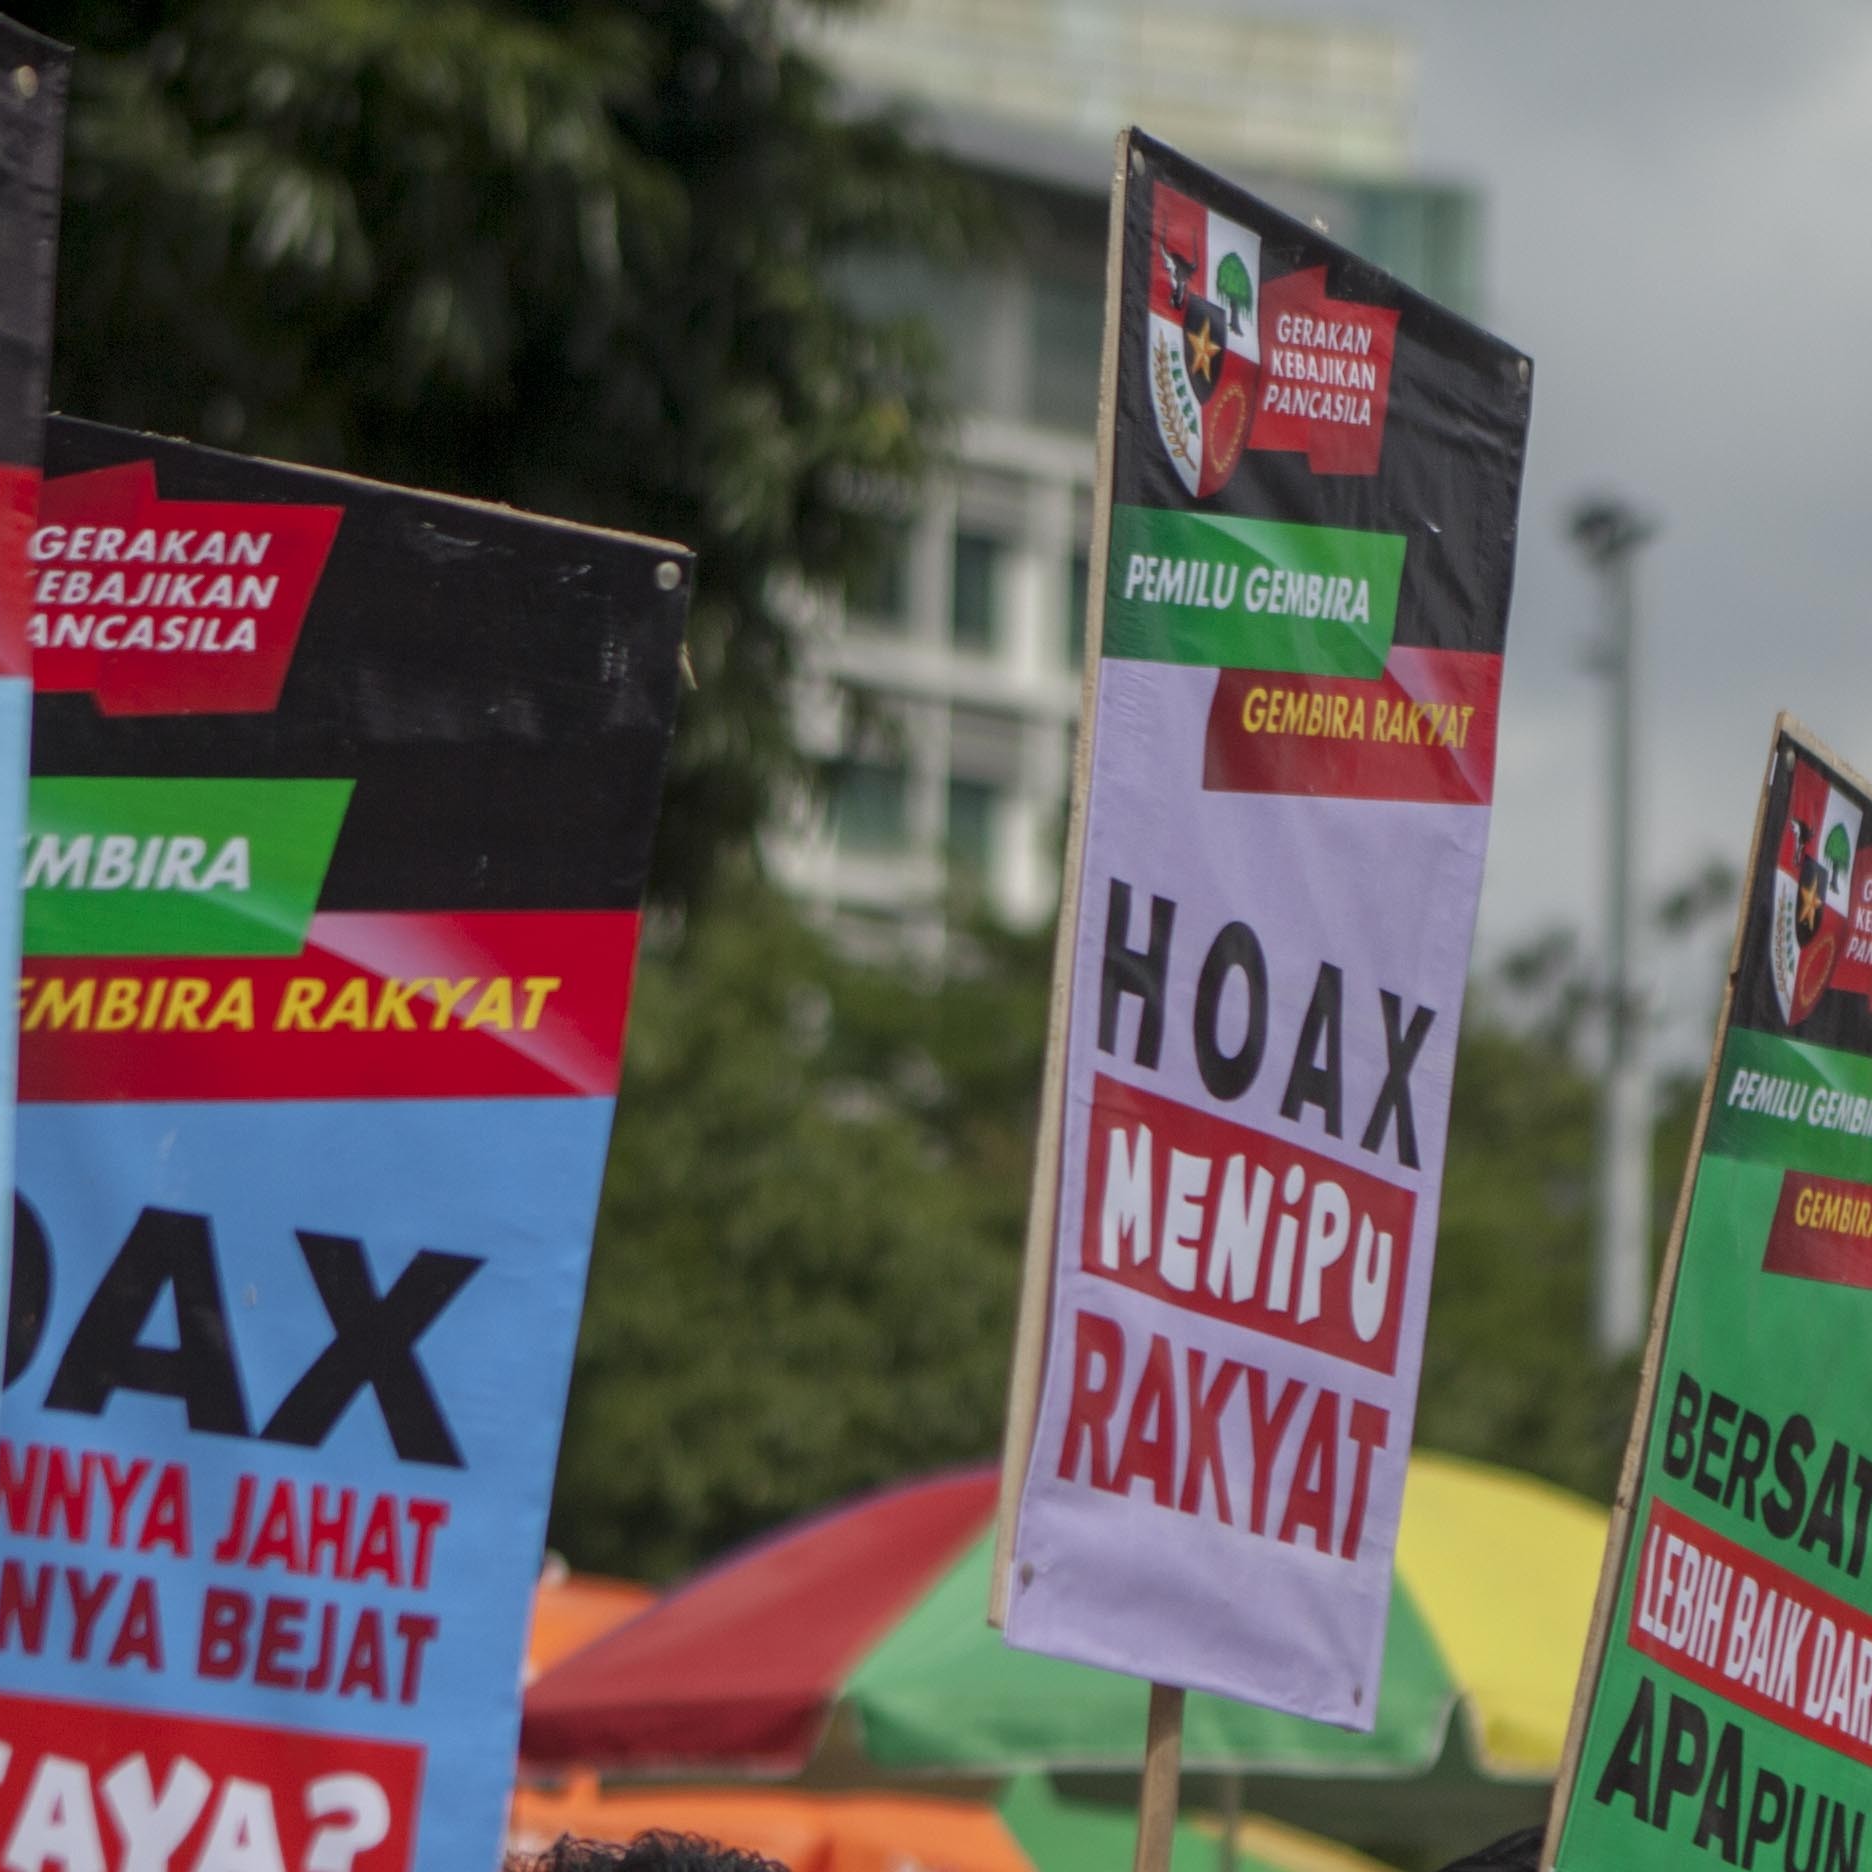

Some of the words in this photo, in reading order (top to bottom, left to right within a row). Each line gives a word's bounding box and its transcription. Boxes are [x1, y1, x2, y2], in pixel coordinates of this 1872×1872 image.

[1277, 314, 1372, 353] GERAKAN
[1271, 350, 1376, 391] KEBAJIKAN
[1263, 386, 1371, 426] PANCASILA
[29, 525, 272, 566] GERAKAN
[28, 569, 280, 610] EBAJIKAN
[1126, 554, 1237, 608] PEMILU
[1245, 566, 1370, 623] GEMBIRA
[27, 613, 258, 653] ANCASILA
[1242, 688, 1365, 741] GEMBIRA
[1372, 700, 1475, 749] RAKYAT
[20, 835, 251, 893] MBIRA
[13, 977, 255, 1032] MBIRA
[274, 976, 561, 1032] RAKYAT
[1098, 878, 1436, 1171] HOAX
[1730, 1070, 1808, 1123] PEMILU
[1057, 1310, 1389, 1562] RAKYAT
[215, 1473, 450, 1591] JAHAT
[1638, 1523, 1732, 1669] LEBIH
[1731, 1577, 1814, 1710] BAIK
[196, 1585, 440, 1706] BEJAT
